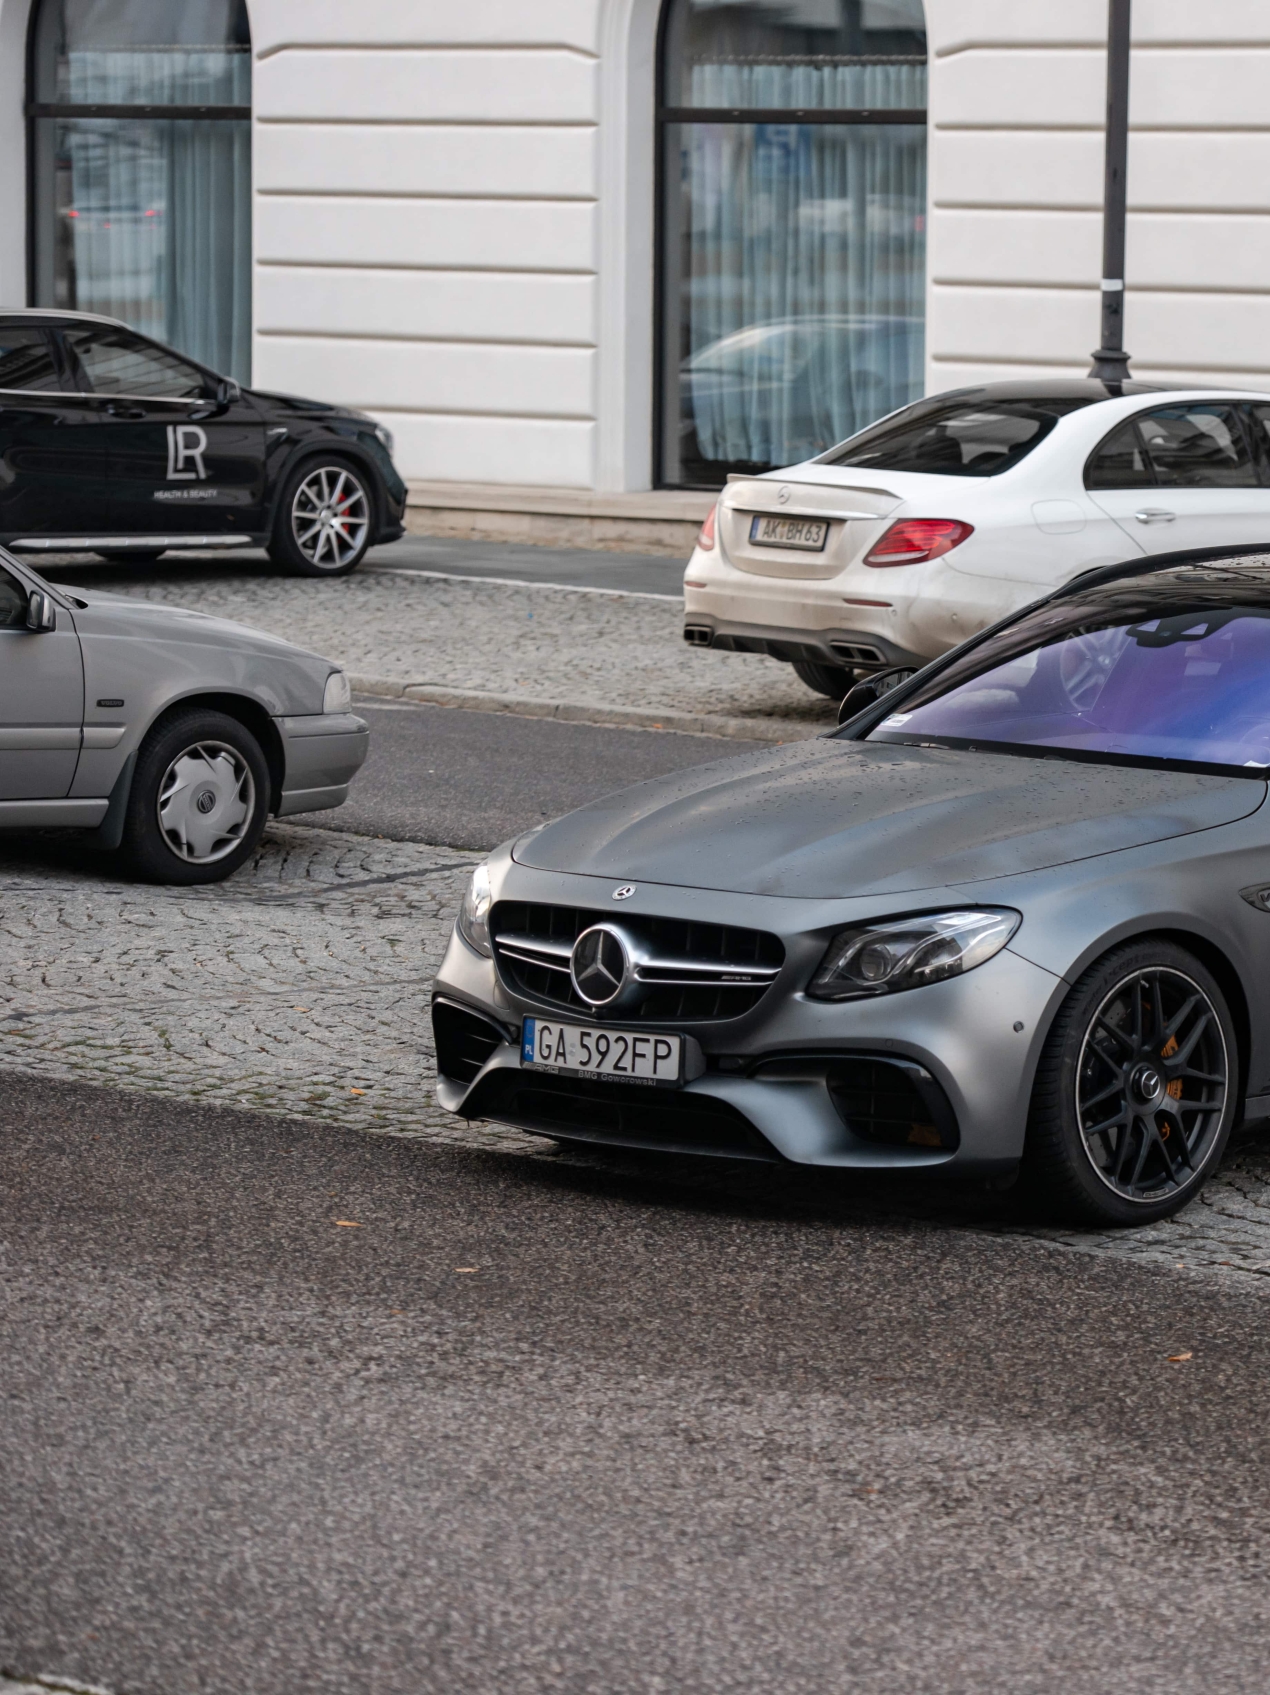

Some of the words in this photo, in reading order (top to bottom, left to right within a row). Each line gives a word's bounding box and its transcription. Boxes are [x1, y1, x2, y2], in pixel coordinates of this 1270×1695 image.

[166, 424, 207, 480] LR
[153, 489, 181, 499] HEALTH
[182, 489, 188, 498] &
[189, 488, 218, 498] BEAUTY
[524, 1044, 534, 1055] PL
[538, 1024, 567, 1064] GA
[578, 1030, 673, 1075] 592FP
[533, 1063, 560, 1074] AMG
[578, 1070, 598, 1080] BMG
[601, 1073, 657, 1086] Goworowski
